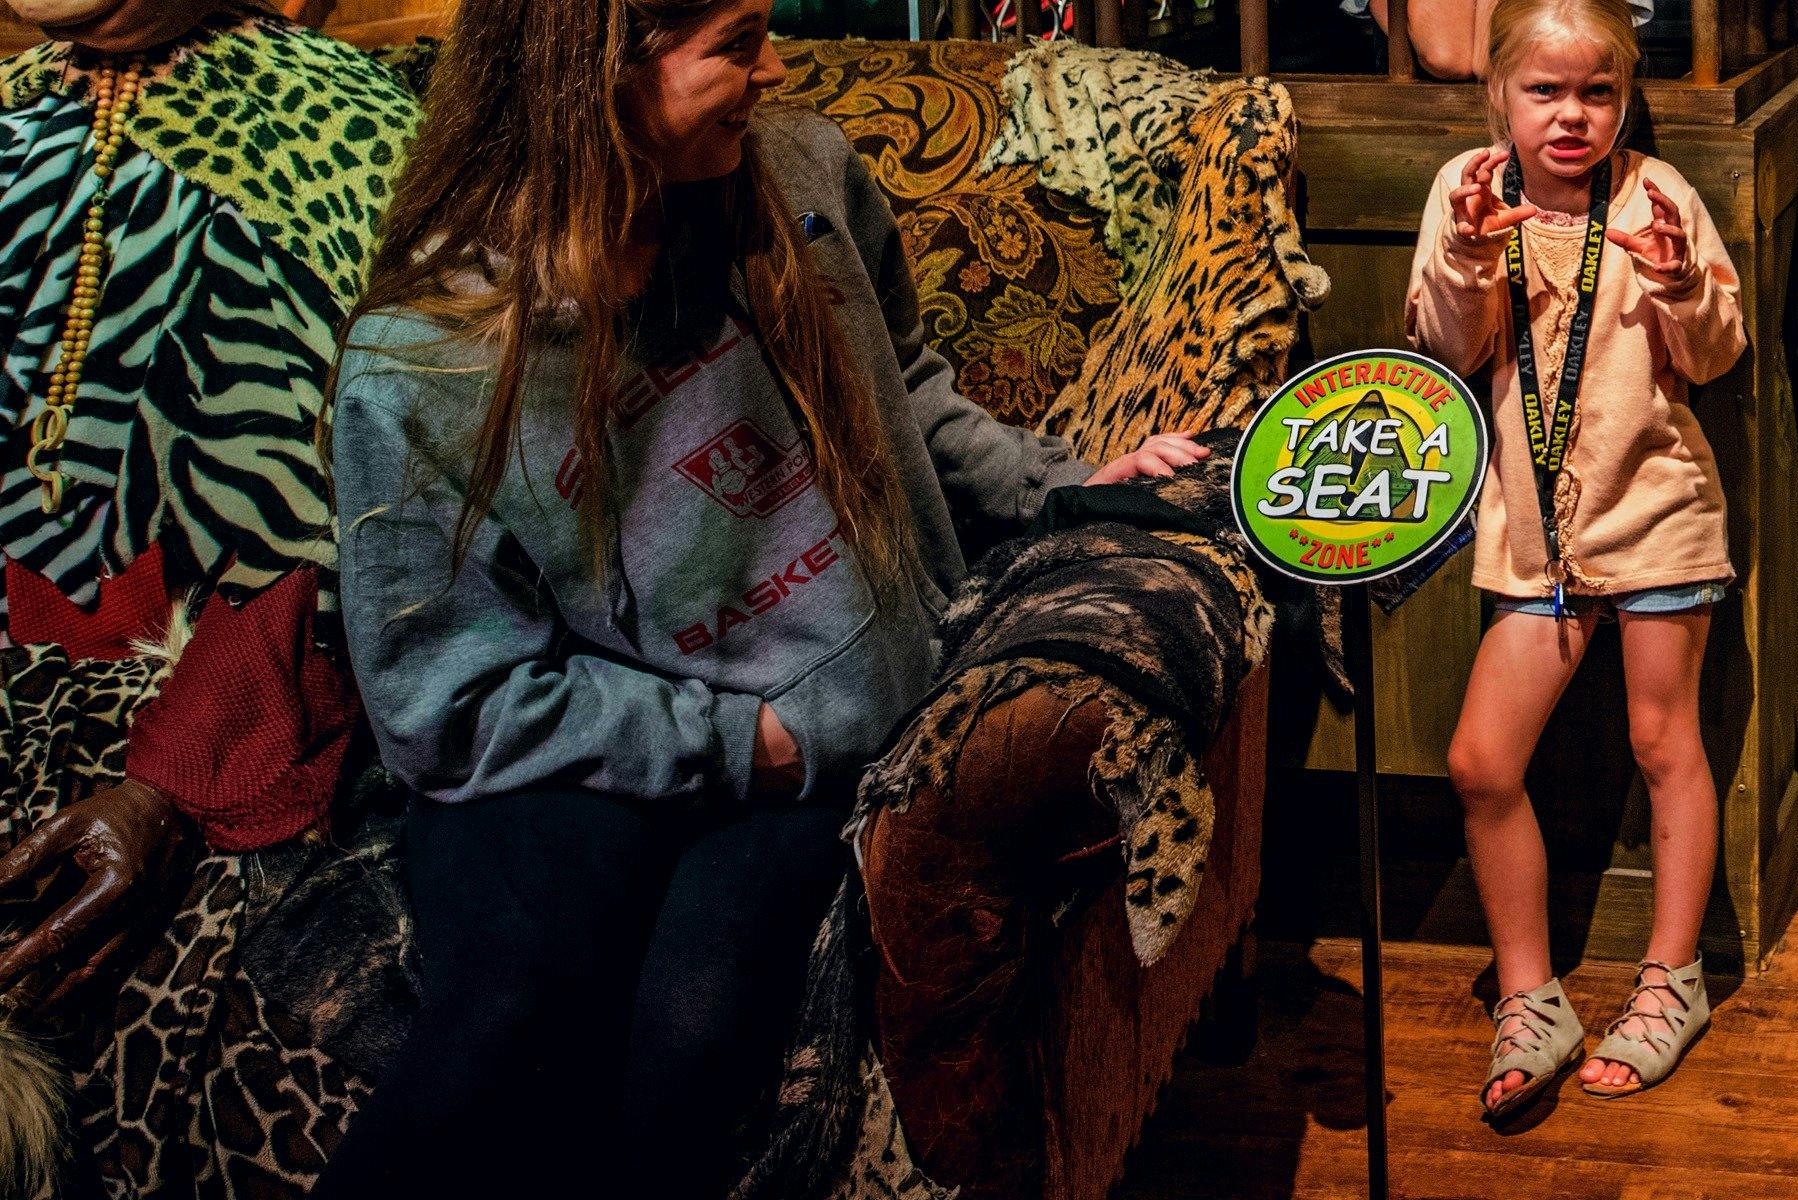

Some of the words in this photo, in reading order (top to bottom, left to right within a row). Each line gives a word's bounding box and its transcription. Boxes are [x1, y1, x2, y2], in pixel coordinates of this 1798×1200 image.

[1507, 228, 1523, 286] AKLEY
[1581, 220, 1604, 292] OAKLEY
[1564, 309, 1589, 382] OAKLEY
[1294, 361, 1456, 413] INTERACTIVE
[1282, 418, 1403, 456] TAKE
[1418, 422, 1452, 456] A
[1523, 392, 1546, 466] OAKLEY
[1548, 399, 1573, 472] OAKLEY
[1257, 464, 1451, 520] SEAT
[1299, 539, 1373, 571] ZONE
